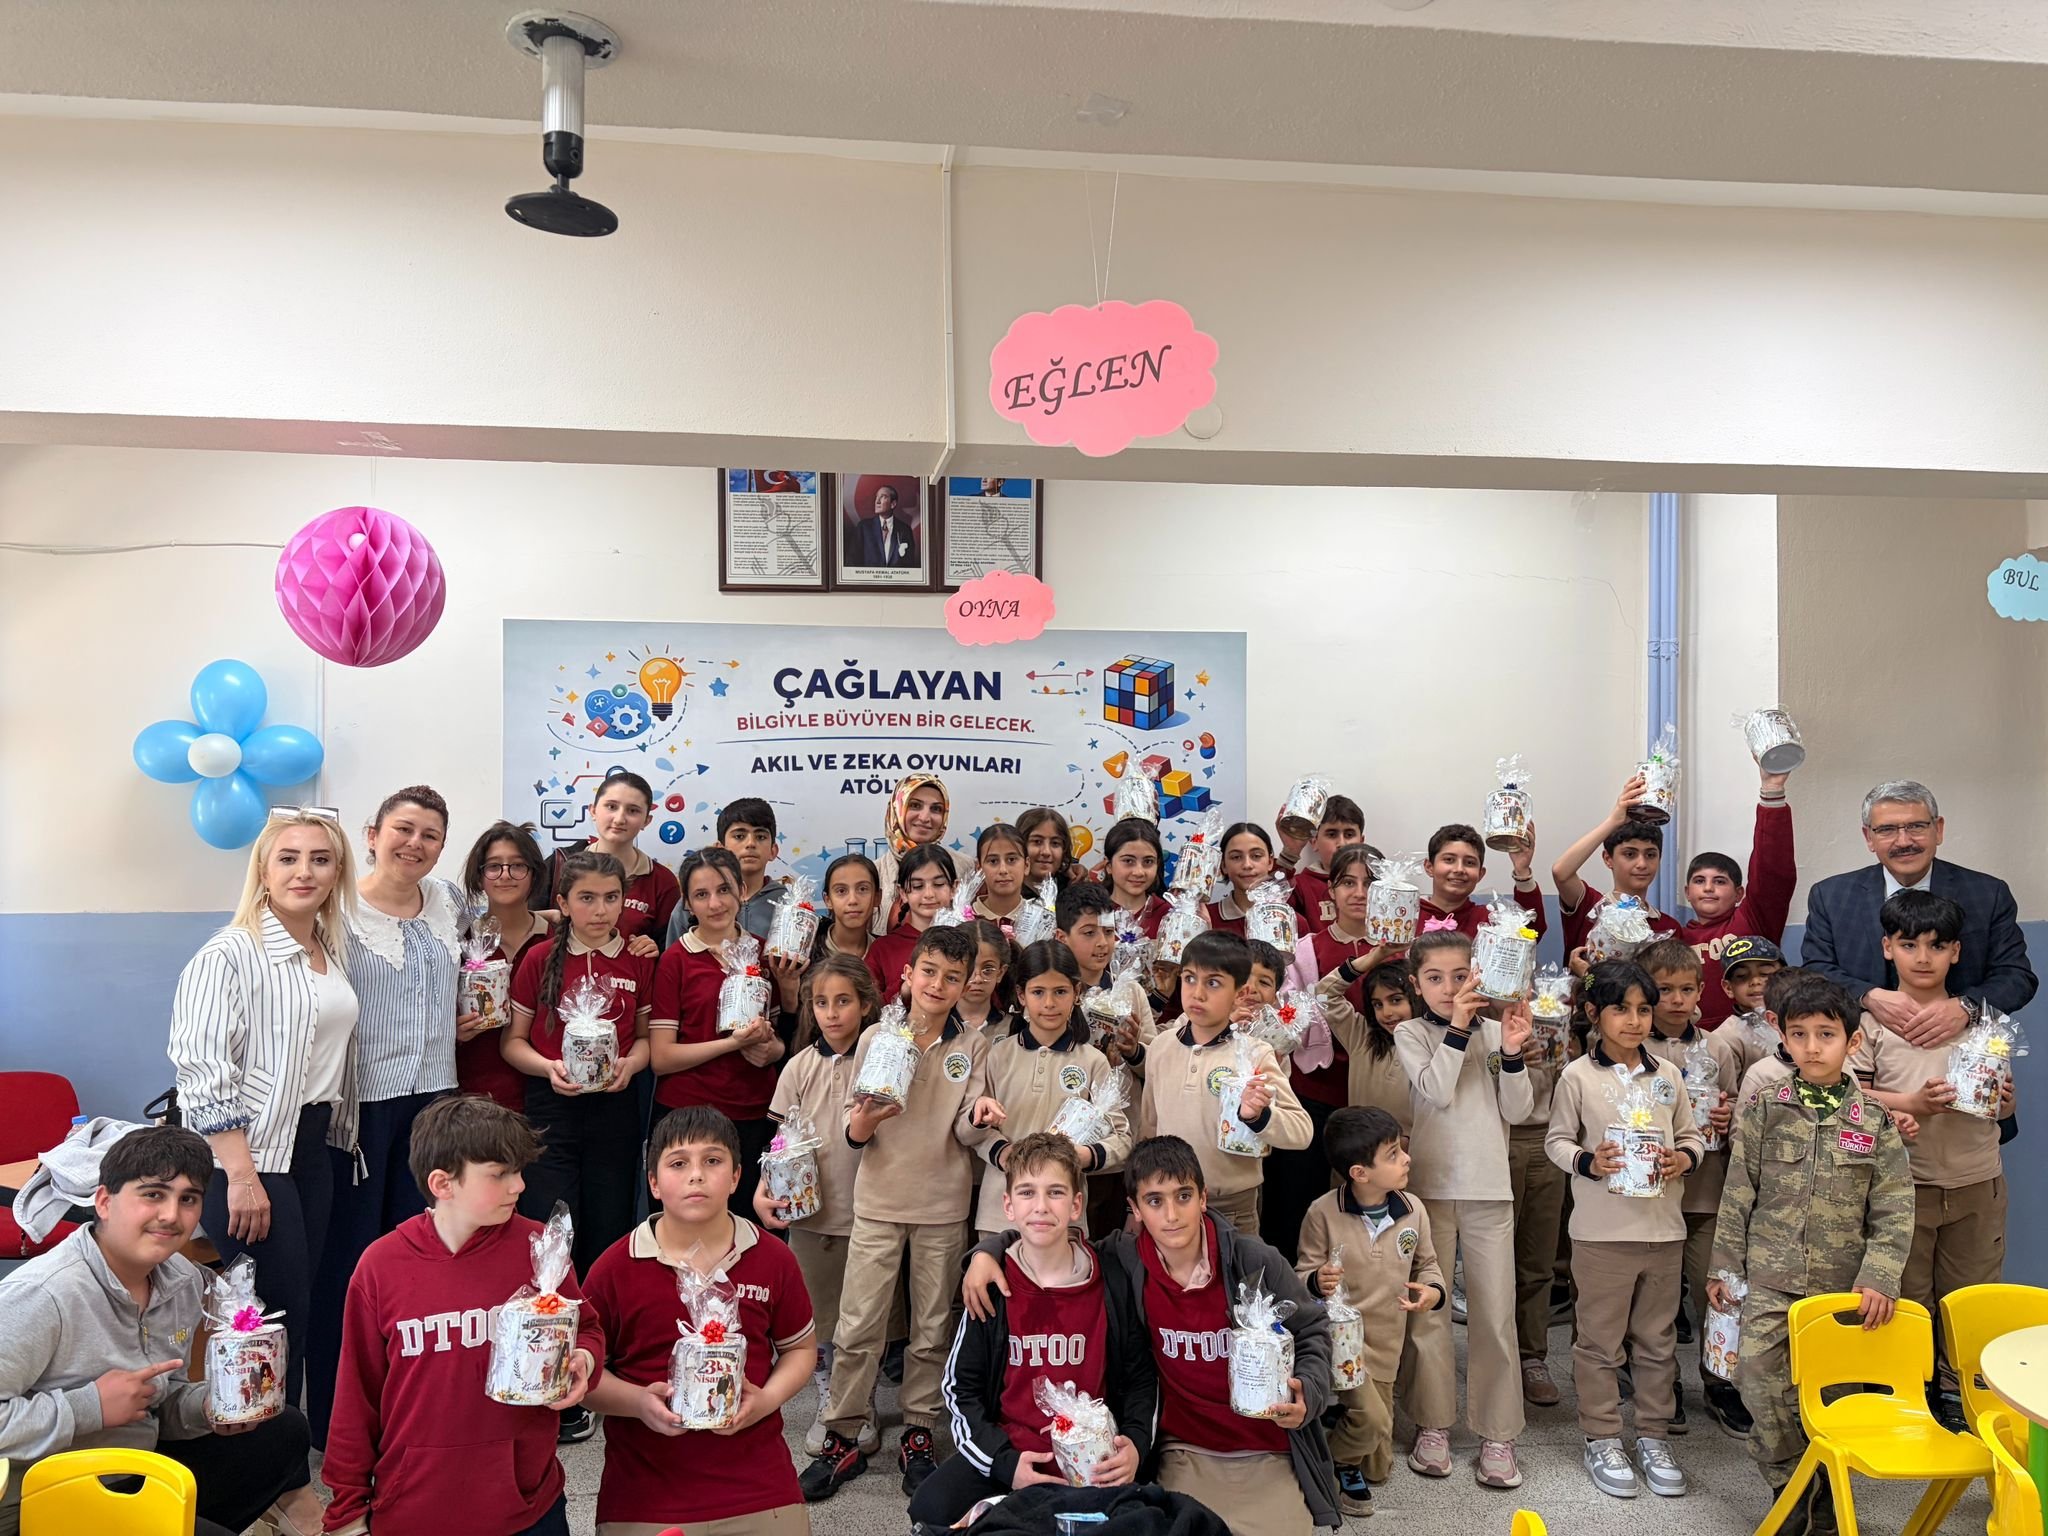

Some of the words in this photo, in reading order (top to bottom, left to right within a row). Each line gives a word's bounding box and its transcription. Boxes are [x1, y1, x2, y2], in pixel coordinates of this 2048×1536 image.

[1004, 345, 1172, 415] EĞLEN
[2003, 569, 2039, 591] BUL
[959, 599, 1020, 619] OYNA
[773, 659, 1001, 708] ÇAĞLAYAN
[737, 711, 819, 730] BİLGİYLE
[824, 709, 911, 727] BÜYÜYEN
[917, 710, 945, 728] BİR
[950, 716, 1035, 733] GELECEK.
[751, 755, 803, 773] AKIL
[808, 754, 838, 770] VE
[843, 753, 902, 770] ZEKA
[907, 755, 1021, 774] OYUNLARI
[624, 898, 649, 913] DTOO
[610, 977, 637, 993] DTOO
[1840, 1140, 1871, 1152] TÜRKİYE
[736, 1283, 770, 1303] DTOO
[1008, 1333, 1086, 1367] DTOO
[1158, 1327, 1233, 1362] DTOO
